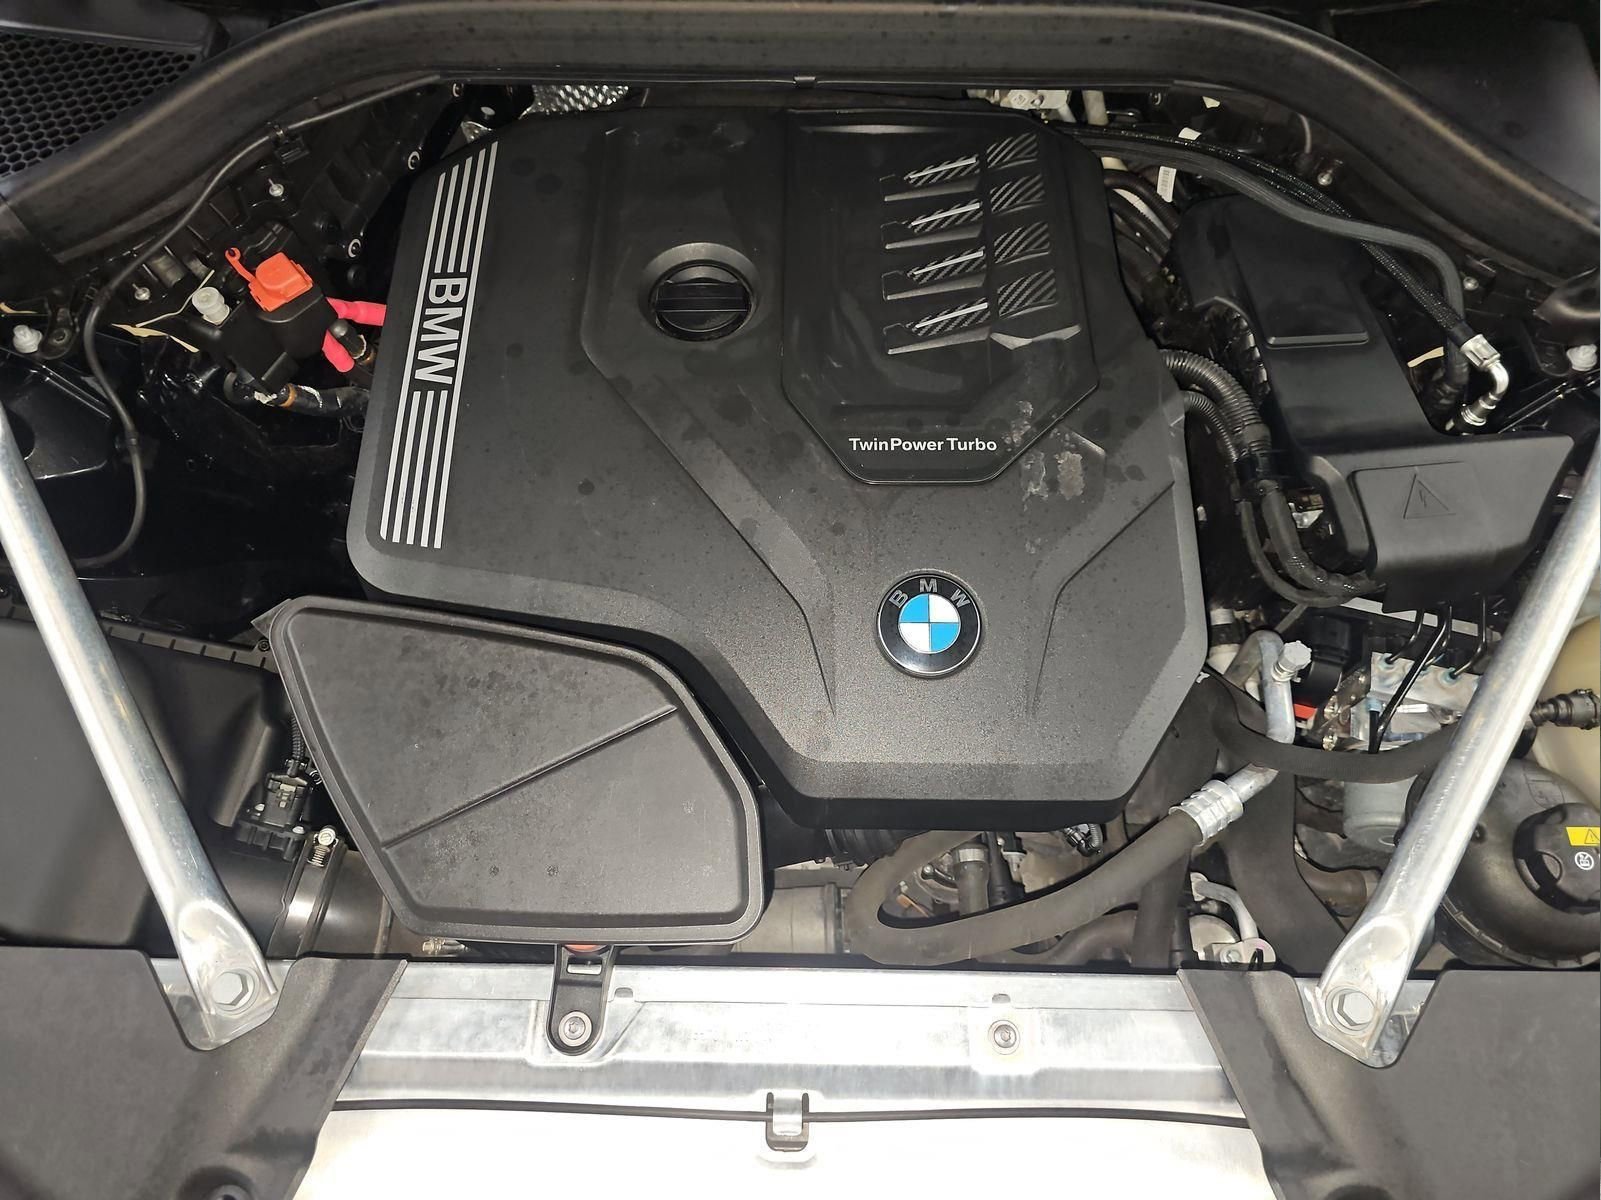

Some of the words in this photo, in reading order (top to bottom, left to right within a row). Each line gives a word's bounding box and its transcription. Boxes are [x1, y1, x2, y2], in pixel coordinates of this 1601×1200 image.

[414, 277, 467, 385] BMW
[848, 437, 944, 451] TwinPower
[946, 437, 997, 451] Turbo
[888, 578, 971, 609] BMW
